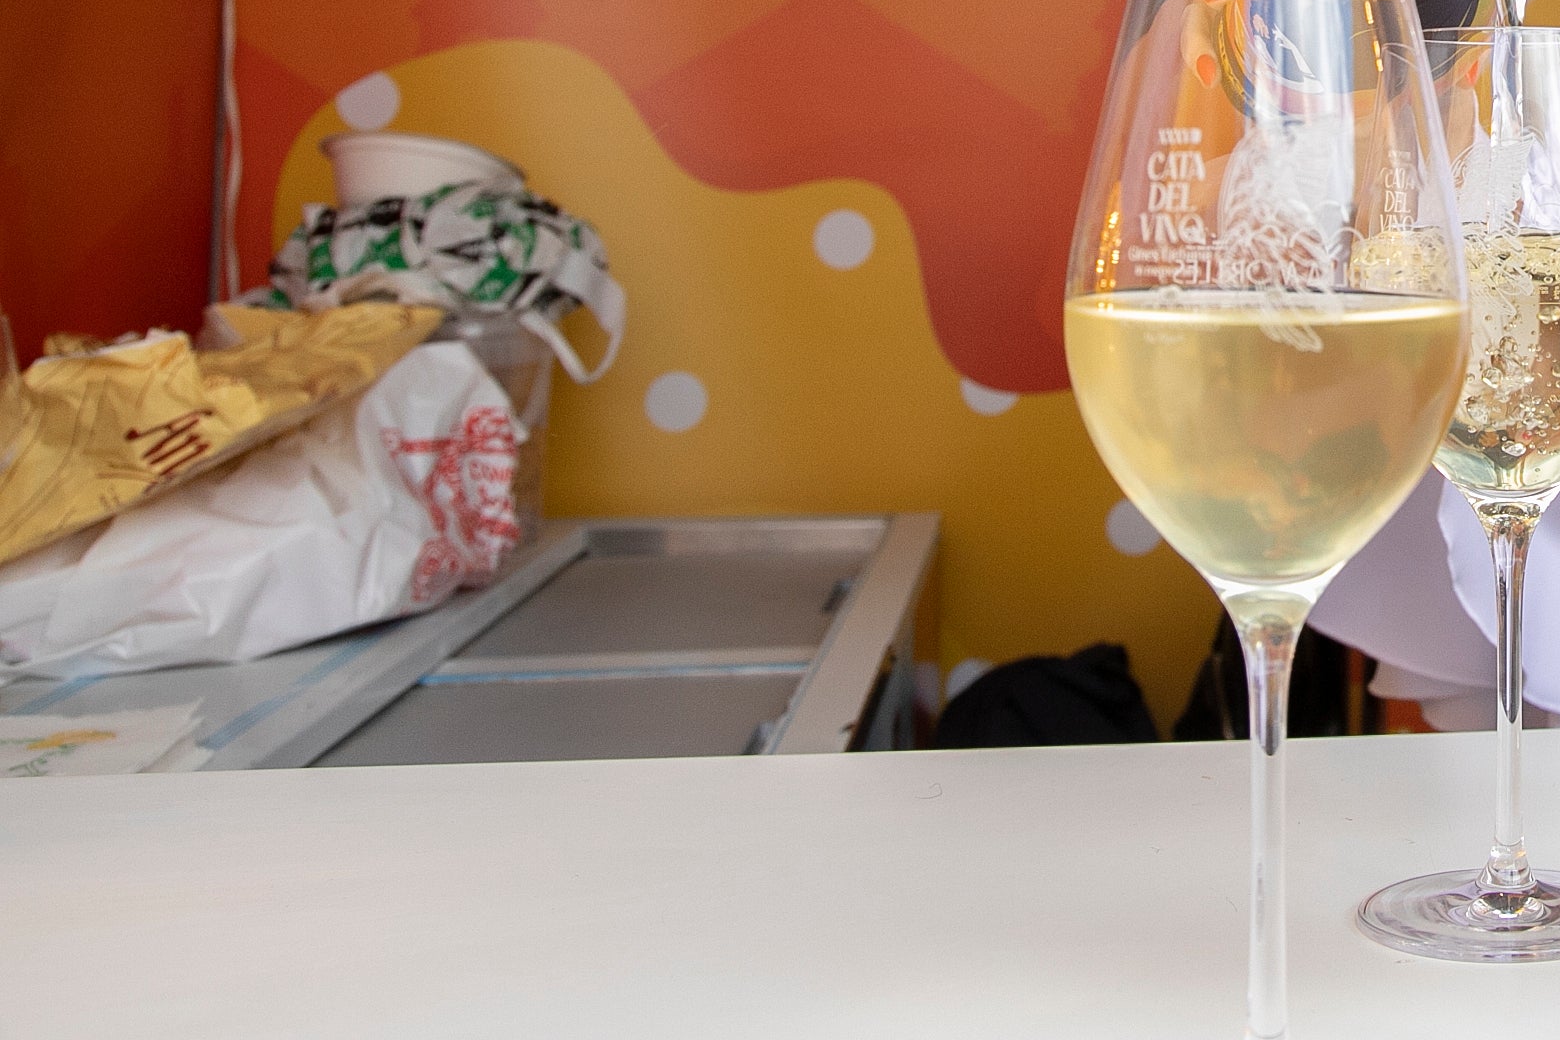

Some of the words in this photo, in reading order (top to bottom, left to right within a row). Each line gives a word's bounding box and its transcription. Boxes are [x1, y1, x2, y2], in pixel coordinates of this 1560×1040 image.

[1147, 149, 1206, 181] CATA
[1148, 181, 1198, 213] DEL
[1383, 190, 1412, 214] DEL
